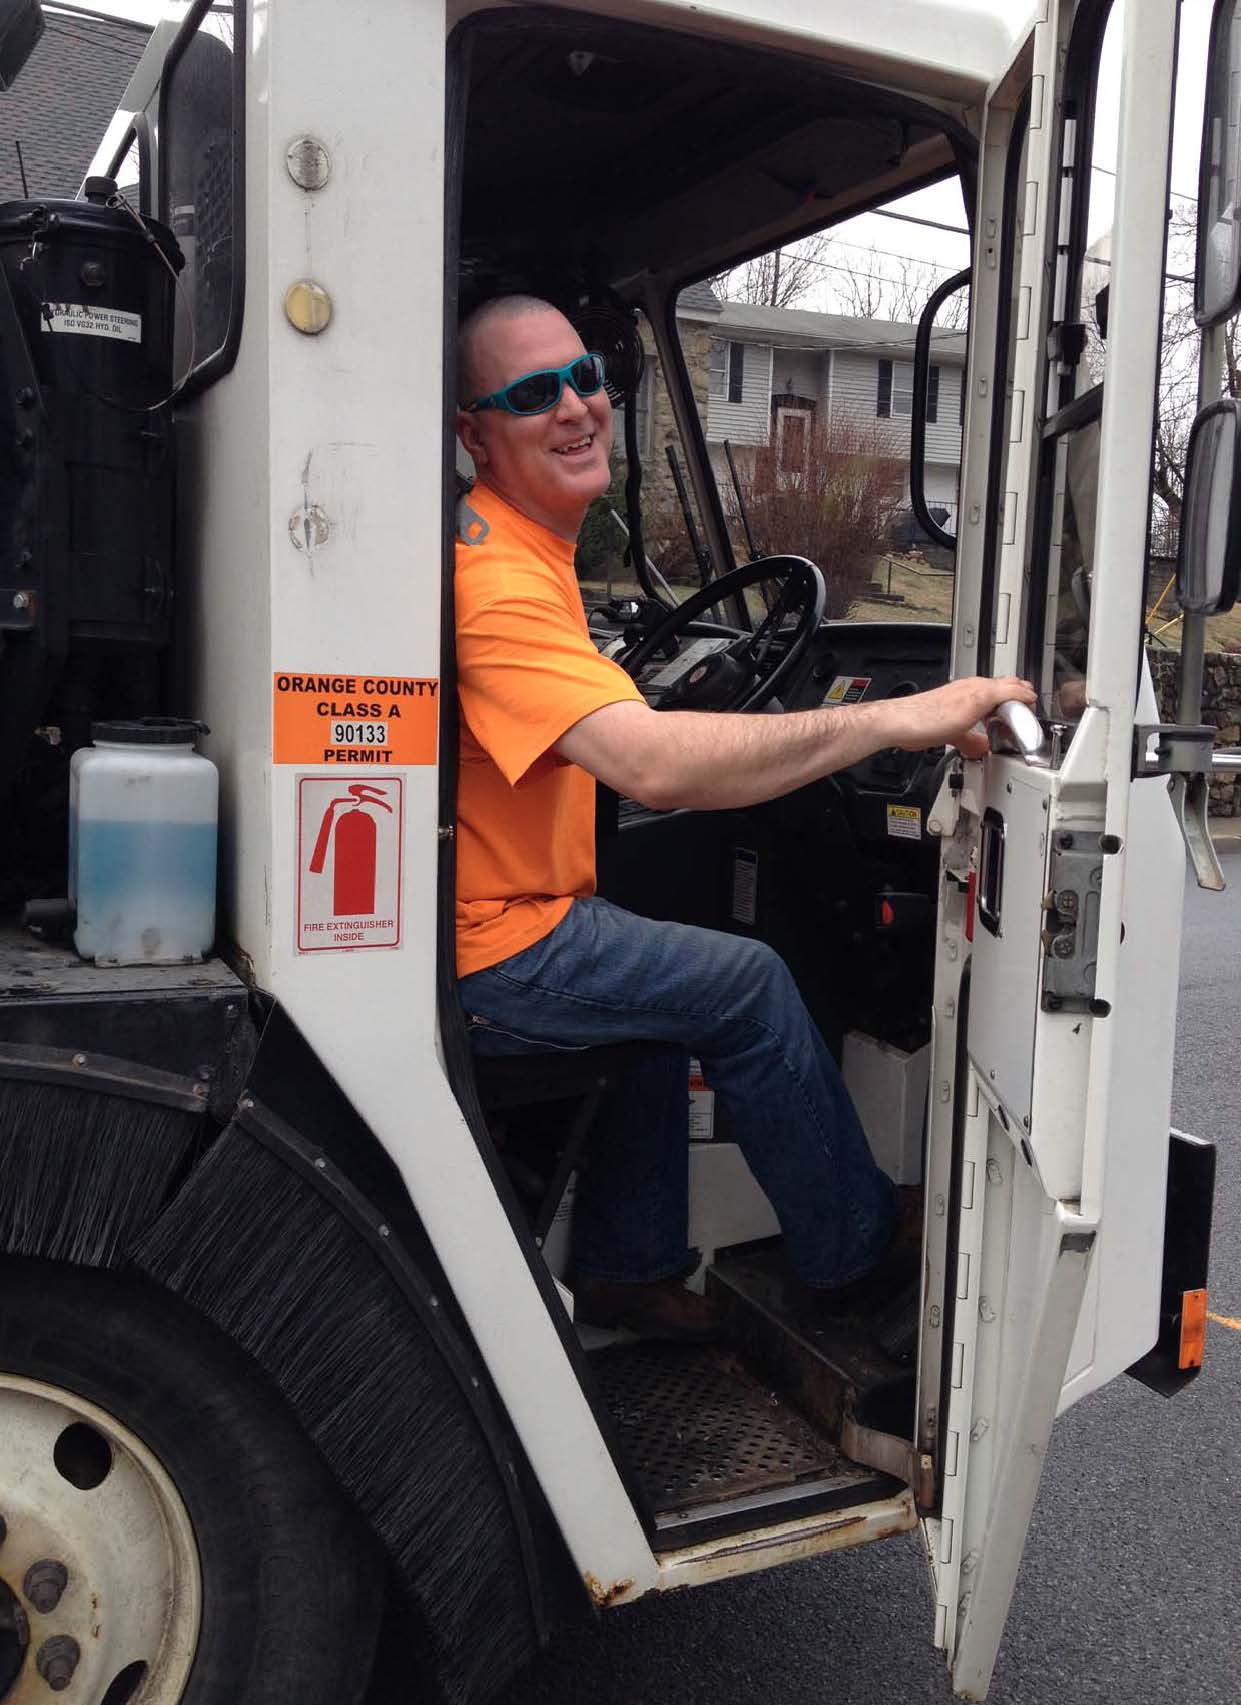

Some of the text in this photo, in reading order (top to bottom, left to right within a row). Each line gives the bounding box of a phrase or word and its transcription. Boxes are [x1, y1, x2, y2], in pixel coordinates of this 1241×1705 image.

[53, 309, 83, 318] DRAULIC
[85, 311, 108, 321] POWER
[64, 319, 75, 327] ISO
[112, 324, 122, 333] OIL
[277, 676, 438, 696] ORANGE COUNTY
[317, 702, 401, 718] CLASS A
[335, 724, 385, 743] 90133
[324, 749, 392, 762] PERMIT
[304, 920, 394, 931] FIRE EXTINGUISHER
[334, 933, 364, 941] INSIDE
